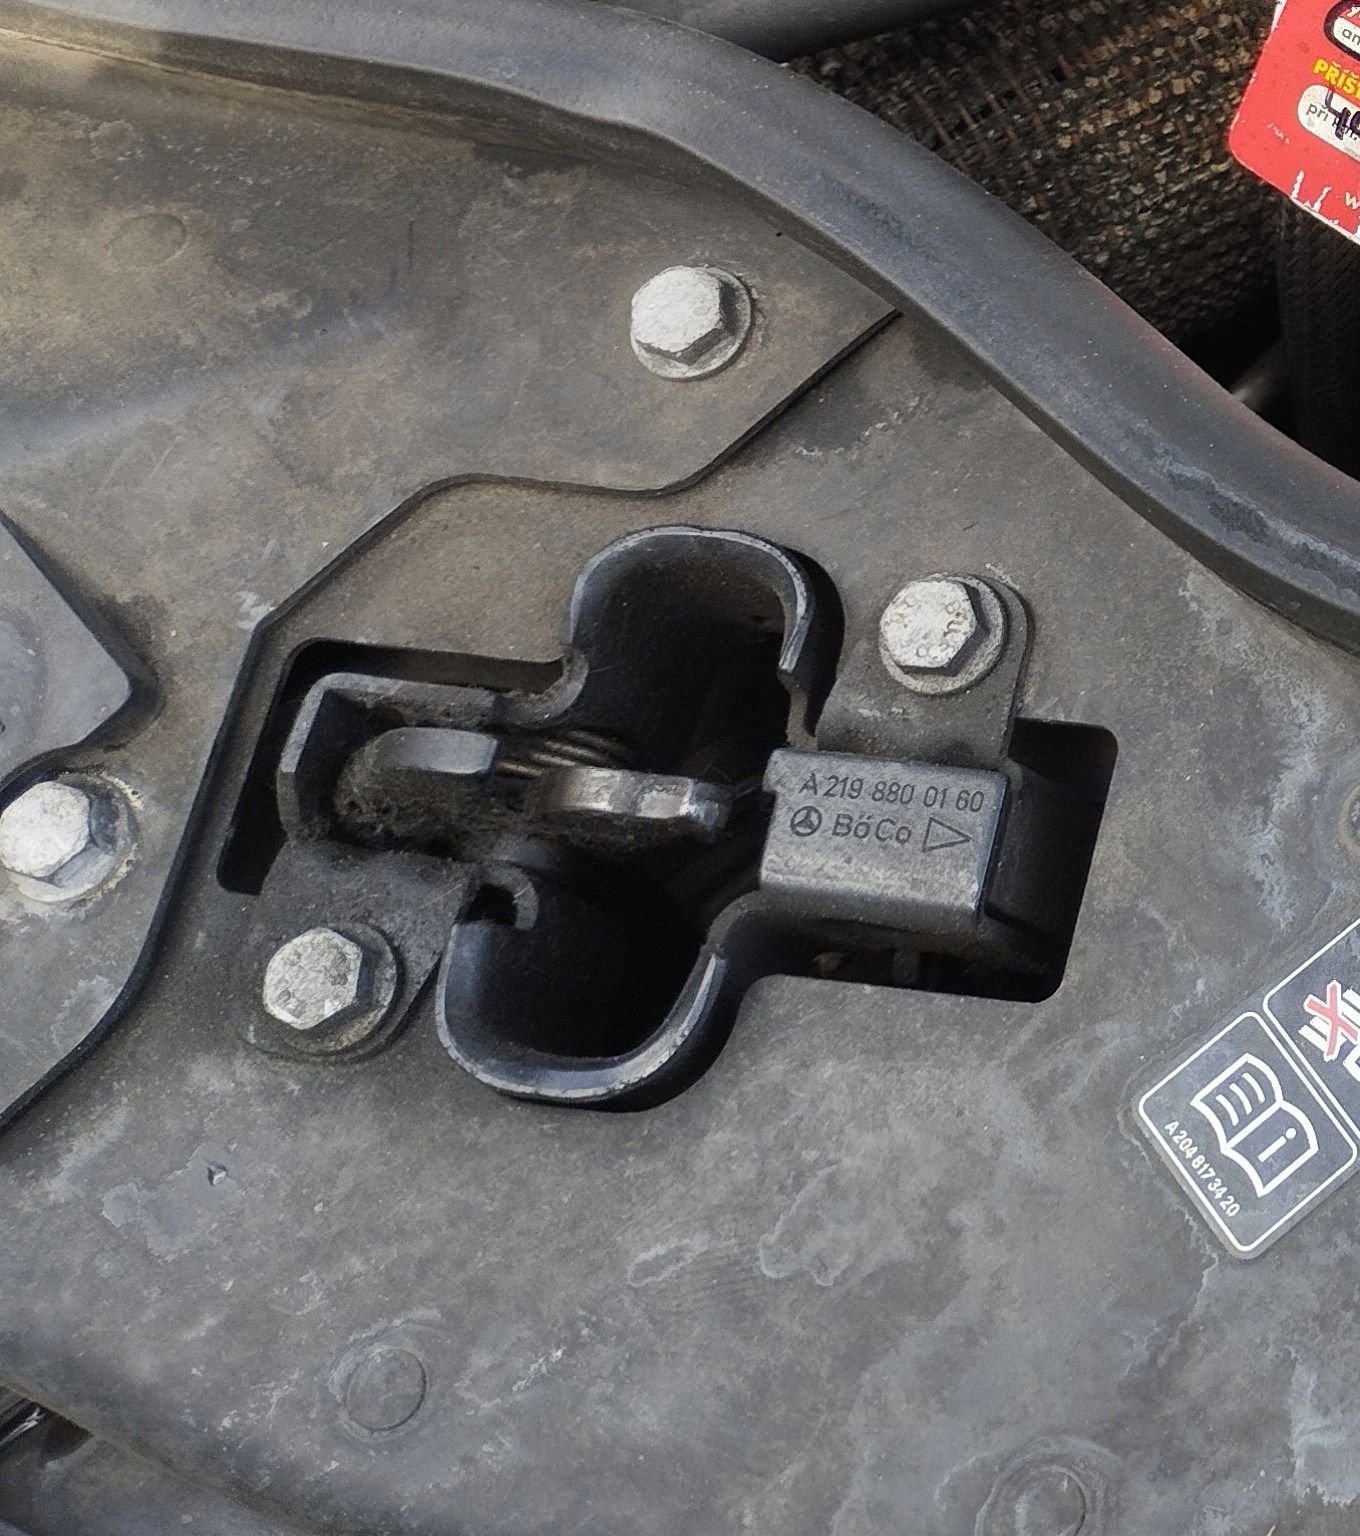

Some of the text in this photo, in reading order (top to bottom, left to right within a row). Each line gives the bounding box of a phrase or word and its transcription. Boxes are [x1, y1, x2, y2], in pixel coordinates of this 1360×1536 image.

[798, 772, 985, 813] A 219 880 01 60
